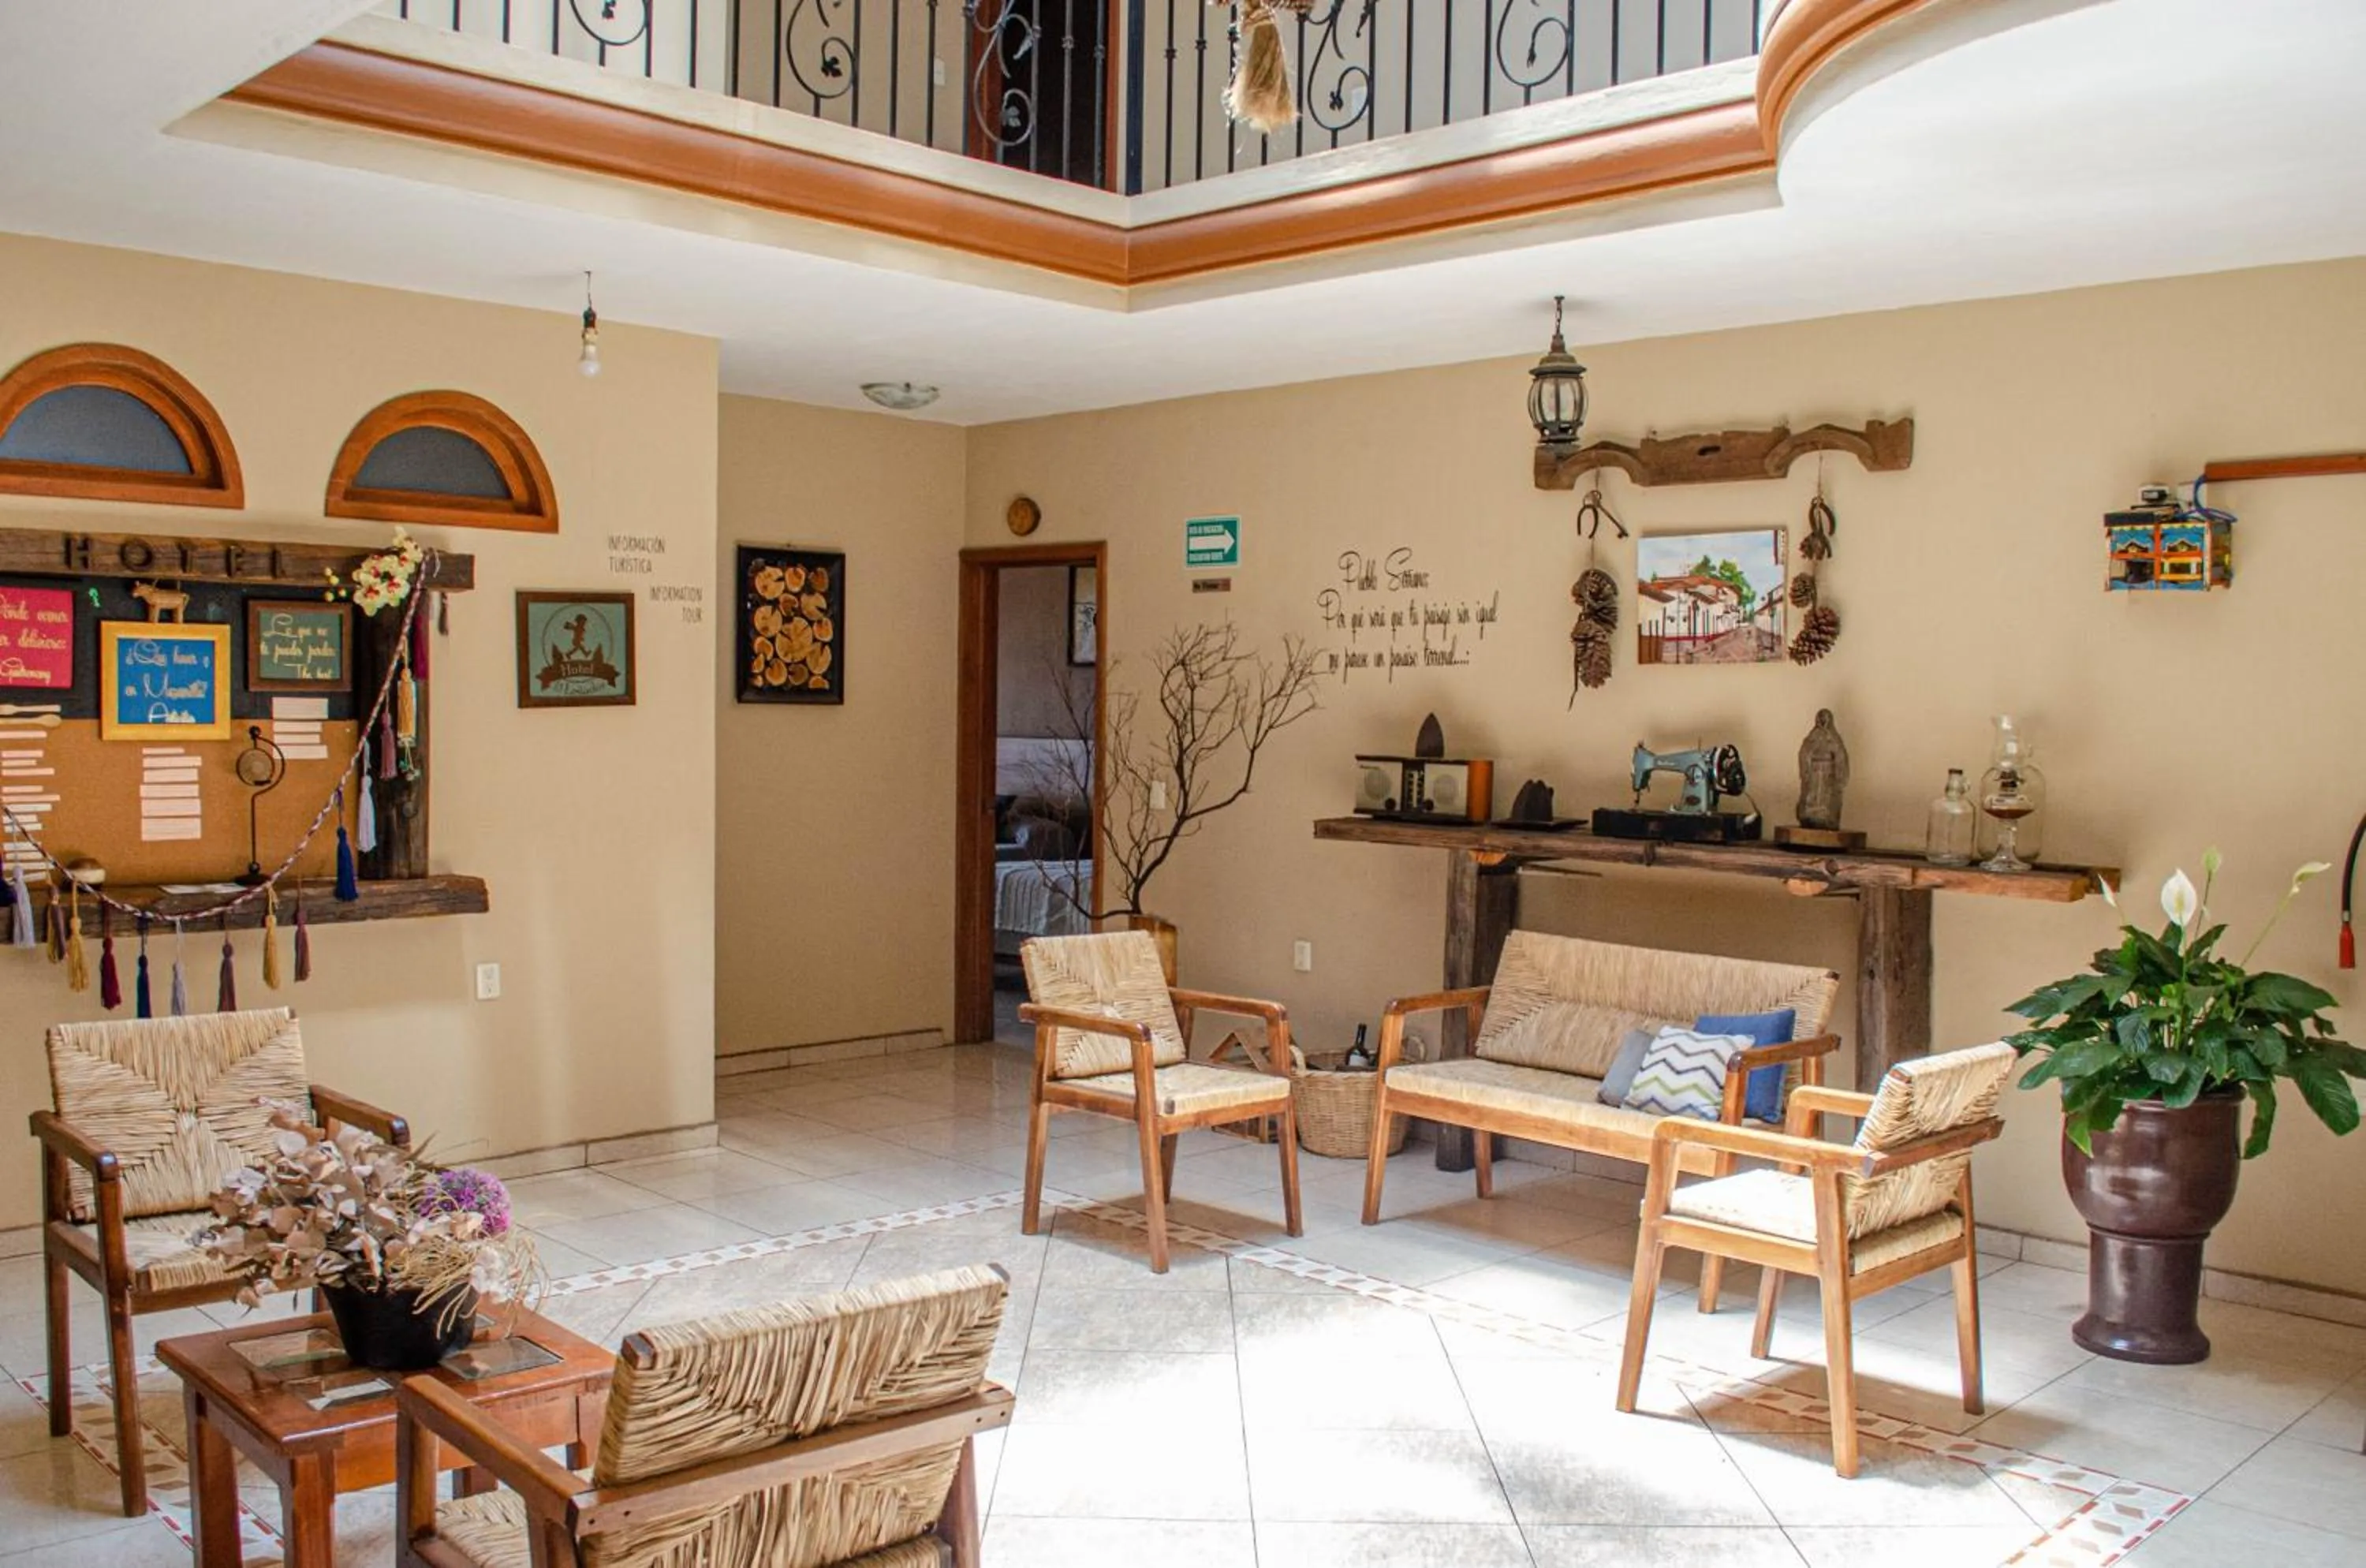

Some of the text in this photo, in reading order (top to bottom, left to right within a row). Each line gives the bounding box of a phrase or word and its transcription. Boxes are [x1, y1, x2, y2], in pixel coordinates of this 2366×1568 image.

[63, 532, 286, 581] HOTEL
[650, 585, 703, 602] INFORMATION
[681, 606, 703, 623] TOUR
[561, 663, 594, 677] Hotel
